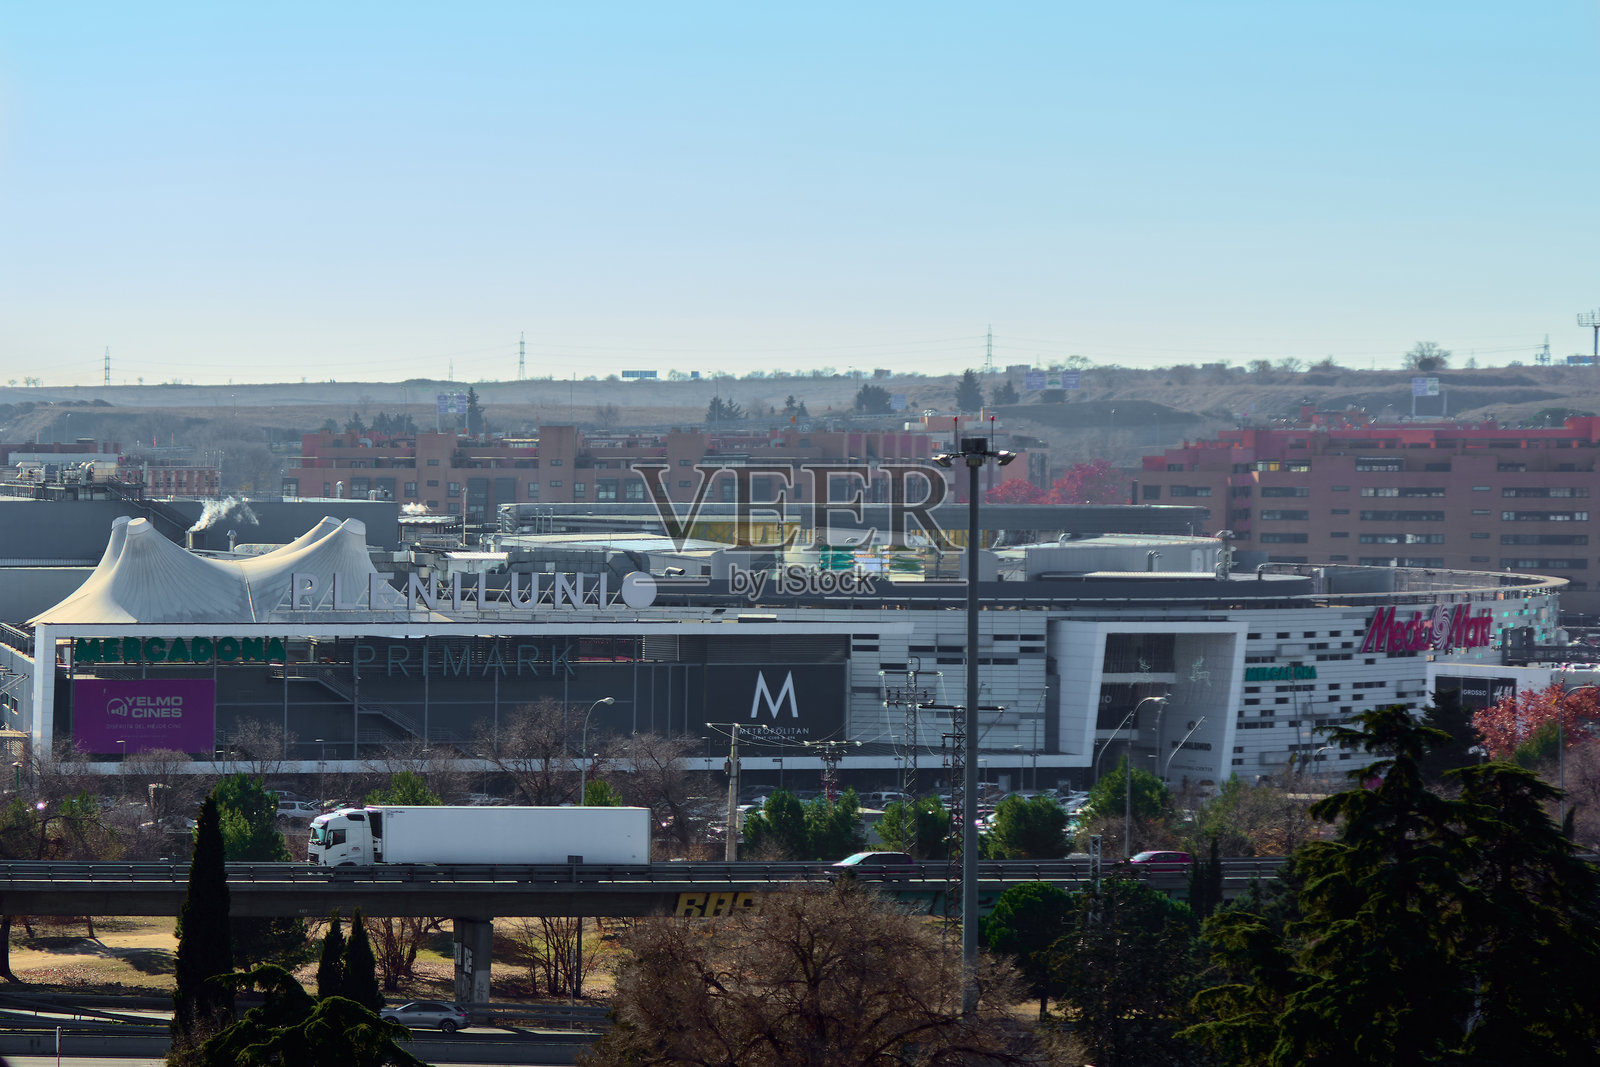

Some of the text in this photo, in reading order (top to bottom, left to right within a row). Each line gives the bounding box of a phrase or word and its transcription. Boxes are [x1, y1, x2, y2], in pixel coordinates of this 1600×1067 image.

[291, 571, 657, 610] PLENILUNIO
[74, 636, 287, 662] MERCADONA
[354, 644, 576, 678] PRIMARK
[125, 696, 183, 706] YELMO
[131, 708, 183, 718] CINES
[739, 727, 810, 735] METROPOLITAN
